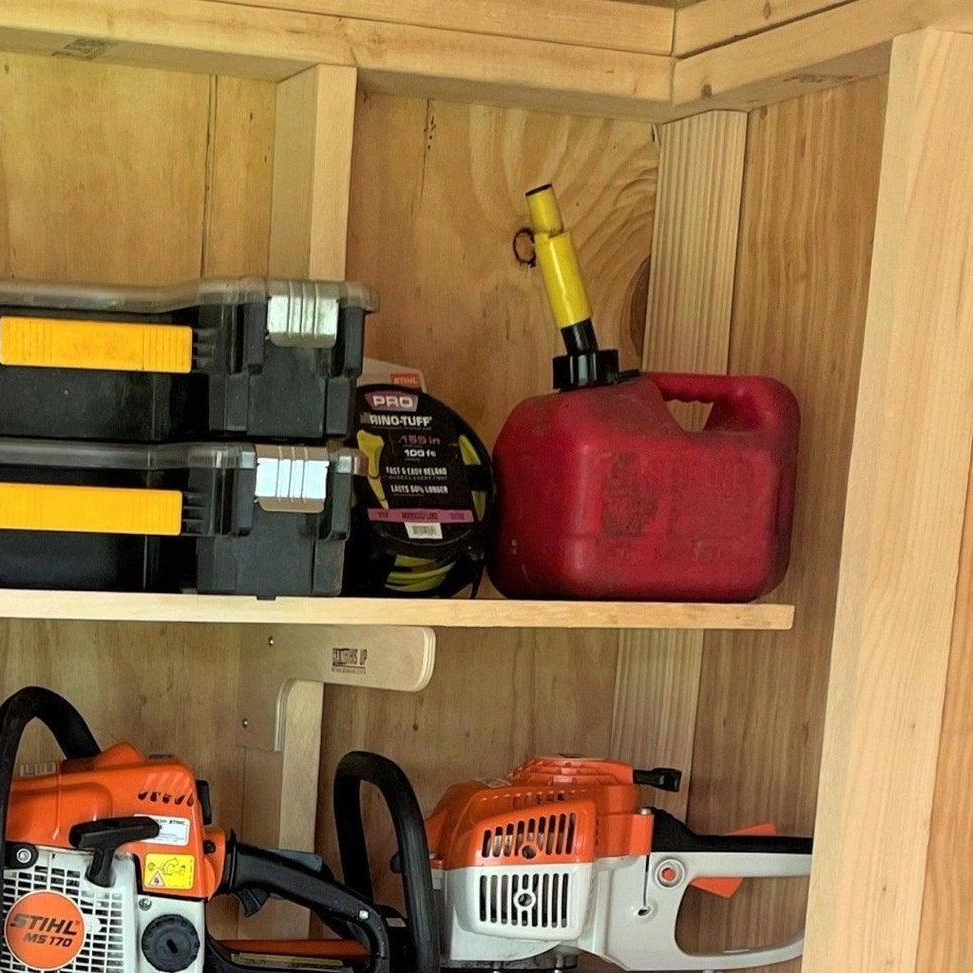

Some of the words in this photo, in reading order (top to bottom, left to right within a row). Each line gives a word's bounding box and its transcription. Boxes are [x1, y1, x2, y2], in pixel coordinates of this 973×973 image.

[373, 396, 414, 408] PRO
[404, 450, 425, 458] 100
[9, 912, 80, 936] STIHL
[23, 932, 46, 943] MS
[49, 936, 73, 948] 170
